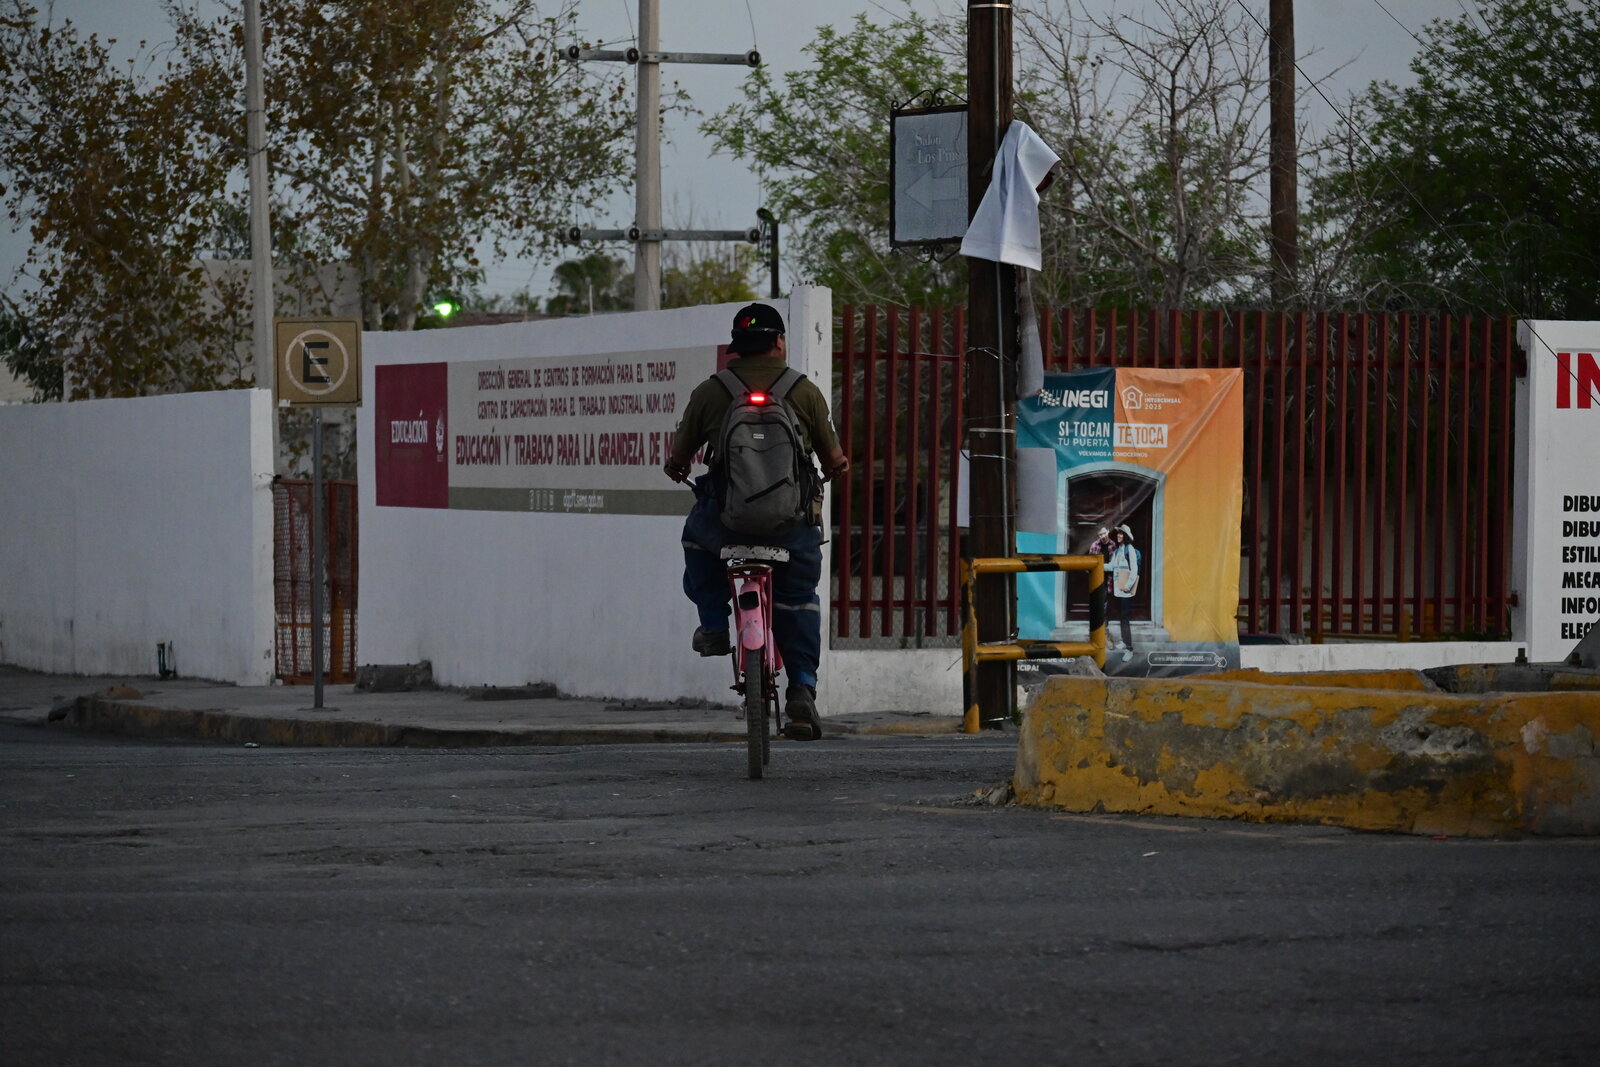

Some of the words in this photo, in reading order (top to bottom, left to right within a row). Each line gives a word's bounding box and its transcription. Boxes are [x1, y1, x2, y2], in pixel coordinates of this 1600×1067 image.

[918, 149, 936, 164] Los
[303, 342, 330, 383] E
[478, 364, 505, 390] DIRECCIÓN
[508, 369, 532, 389] GENERAL
[534, 369, 541, 388] DE
[543, 367, 569, 388] CENTROS
[572, 366, 579, 387] DE
[581, 358, 615, 386] FORMACIÓN
[617, 364, 634, 384] PARA
[636, 363, 644, 383] EL
[647, 361, 676, 382] TRABAJO
[478, 400, 498, 420] CENTRO
[501, 400, 508, 420] DE
[510, 393, 548, 418] CAPACITACIÓN
[550, 397, 568, 417] PARA
[570, 397, 576, 417] EL
[579, 395, 606, 416] TRABAJO
[608, 394, 643, 414] INDUSTRIAL
[662, 392, 675, 414] 009
[1062, 389, 1109, 409] INEGI
[391, 409, 428, 444] EDUCACIÓN
[1059, 421, 1070, 437] SI
[1073, 421, 1111, 438] TOCAN
[1118, 425, 1132, 444] TE
[1135, 426, 1165, 445] TOCA
[456, 426, 501, 466] EDUCACIÓN
[504, 435, 511, 466] Y
[514, 435, 554, 466] TRABAJO
[556, 434, 581, 466] PARA
[584, 433, 596, 466] LA
[598, 432, 646, 466] GRANDEZA
[649, 432, 661, 466] DE
[1058, 437, 1070, 447] TU
[1073, 438, 1110, 447] PUERTA
[1563, 495, 1600, 512] DIBU
[1562, 520, 1600, 538] DIBU
[1562, 545, 1600, 563] ESTIL
[1561, 571, 1600, 589] MECA
[1561, 597, 1600, 614] INFO
[1016, 664, 1040, 672] ICIPA!
